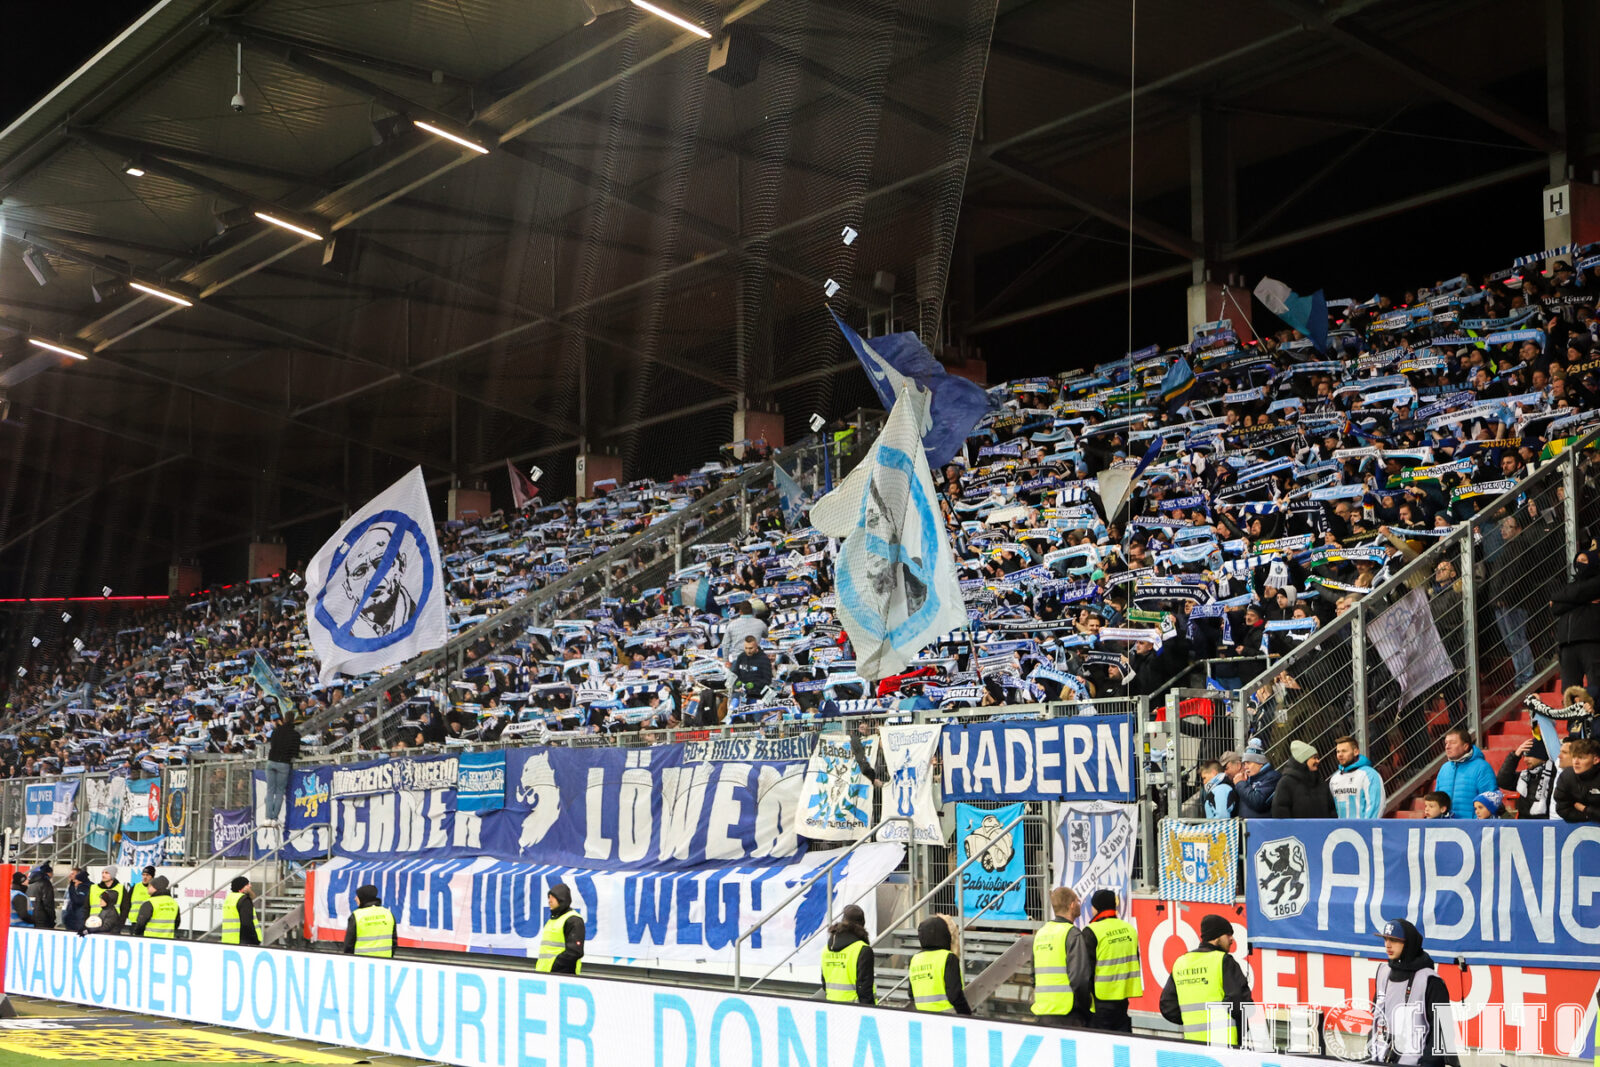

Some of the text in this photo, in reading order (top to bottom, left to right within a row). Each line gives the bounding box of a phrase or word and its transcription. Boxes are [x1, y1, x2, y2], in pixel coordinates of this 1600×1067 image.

[1550, 192, 1563, 212] H
[711, 739, 751, 760] MUSS
[942, 722, 1131, 795] HADERN
[584, 750, 807, 863] LÖWEN
[1273, 900, 1298, 917] 1860
[1317, 825, 1600, 944] AUBING
[222, 950, 596, 1067] DONAUKURIER
